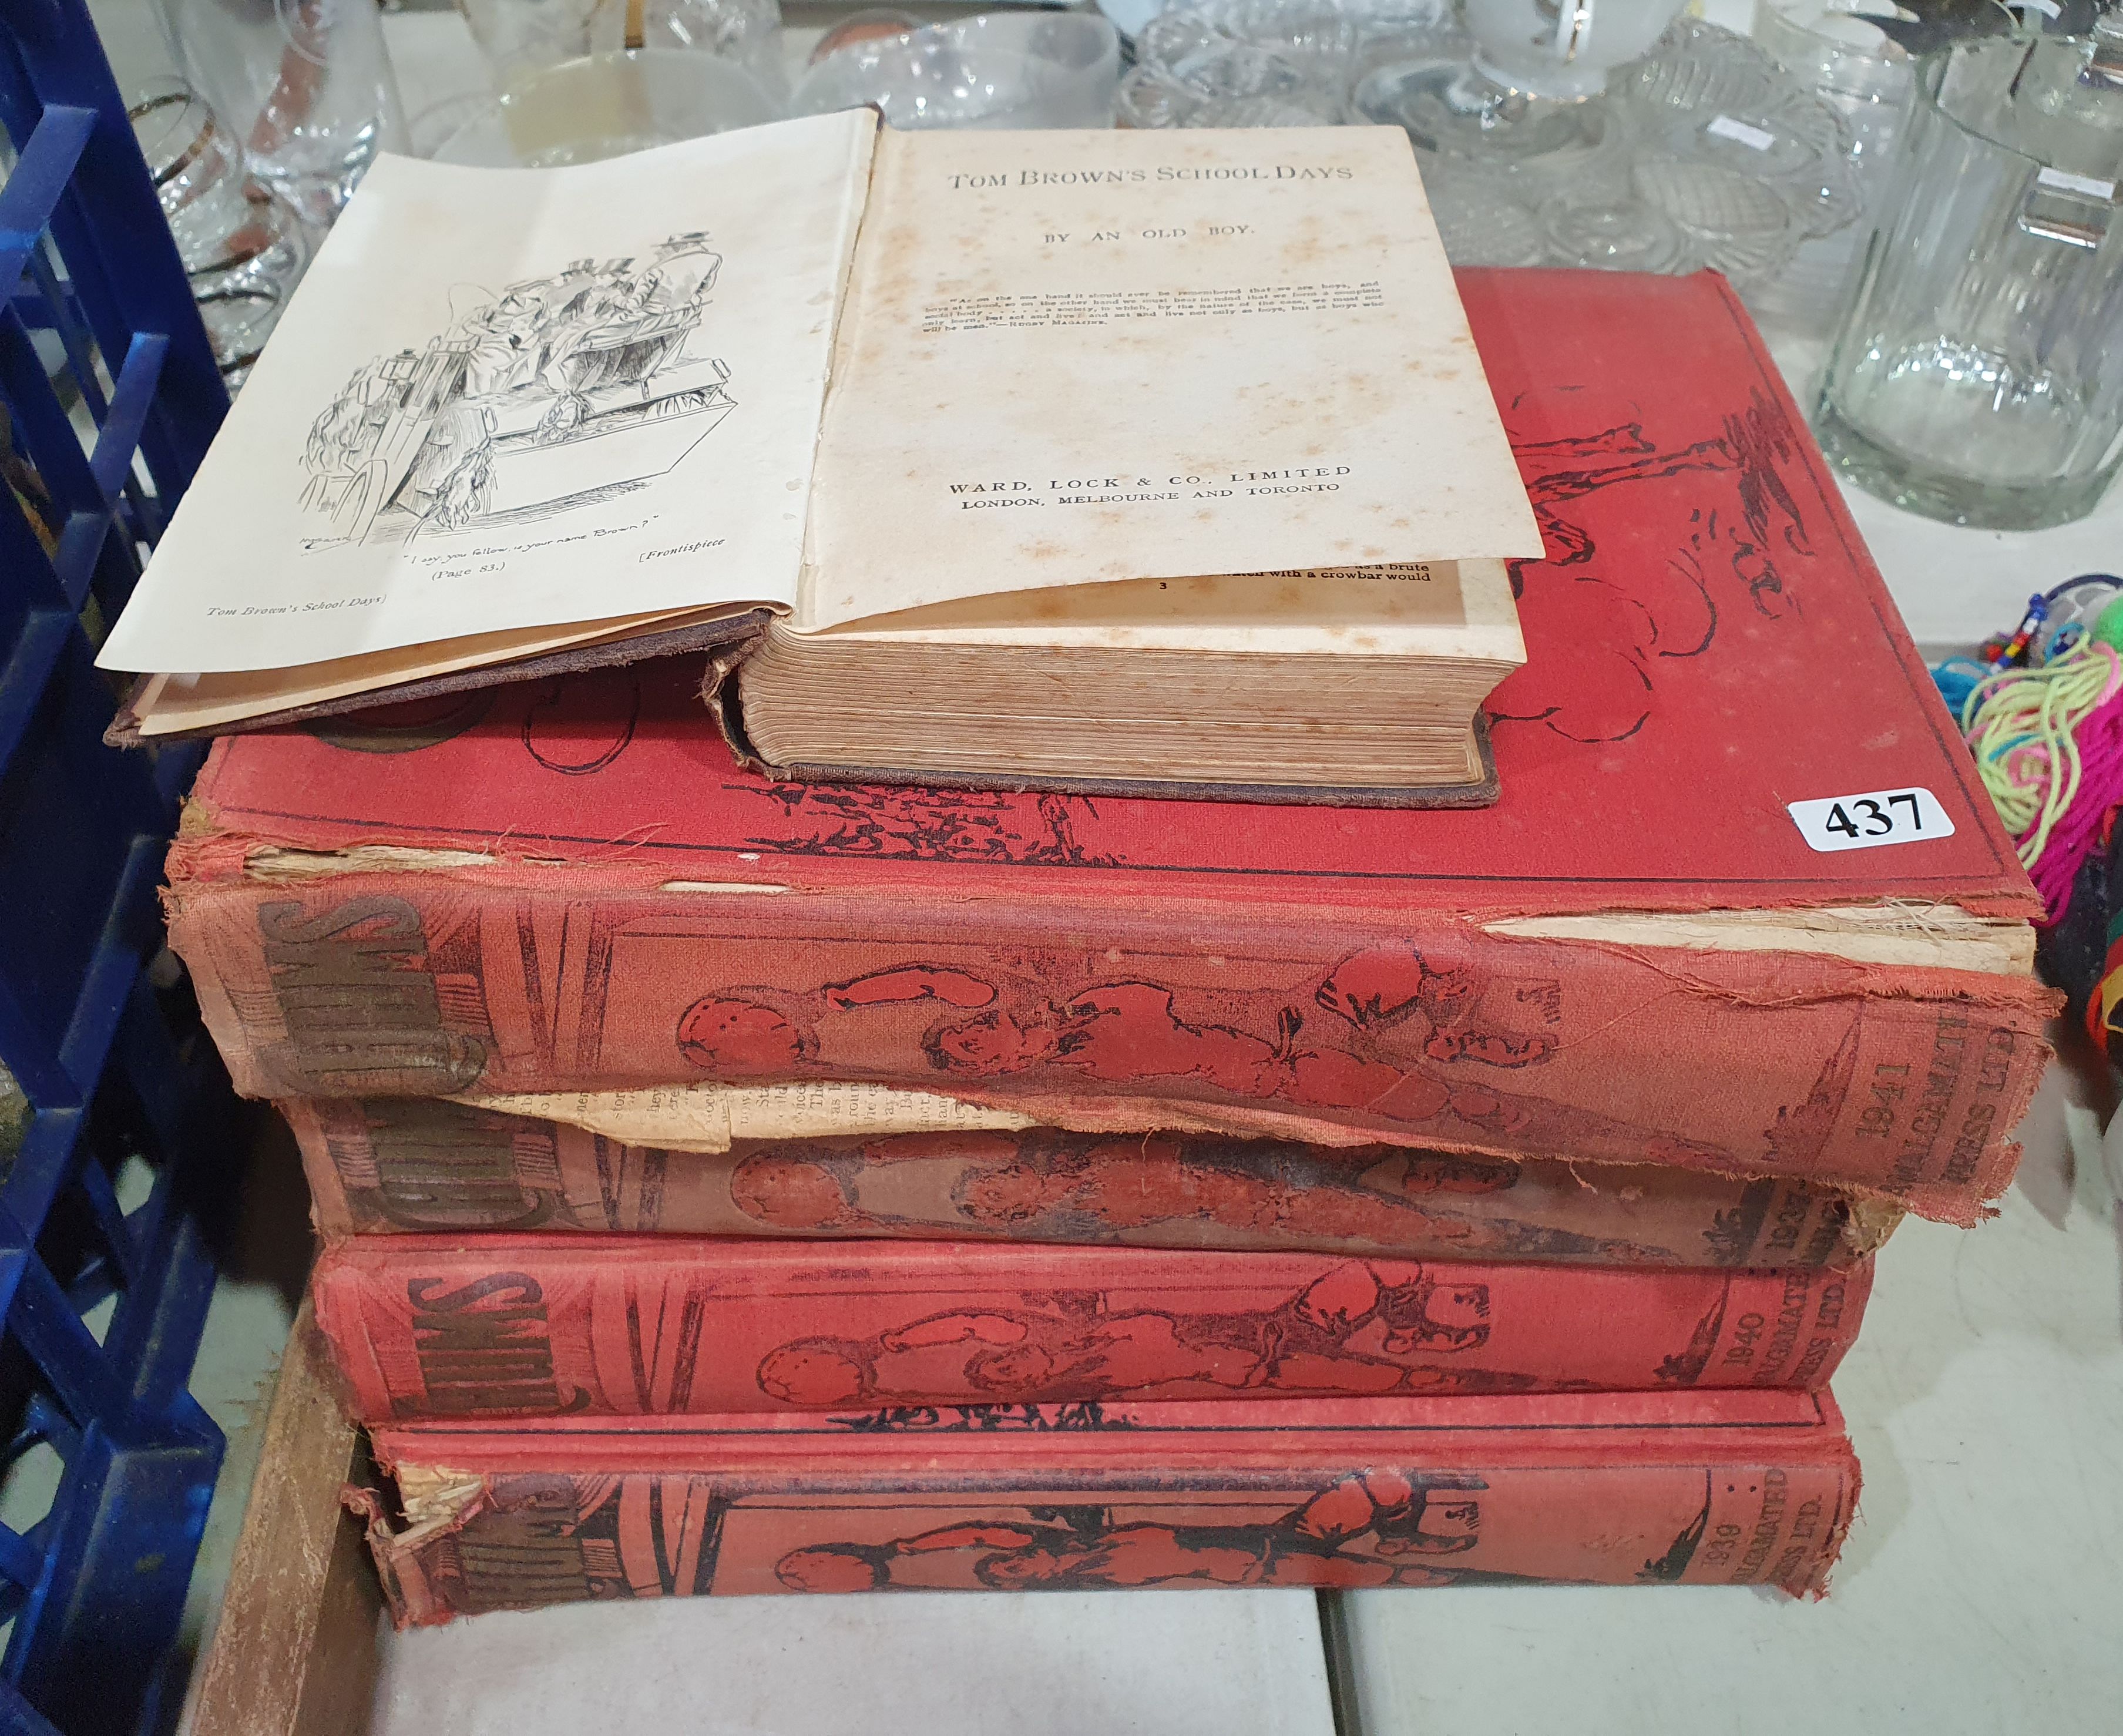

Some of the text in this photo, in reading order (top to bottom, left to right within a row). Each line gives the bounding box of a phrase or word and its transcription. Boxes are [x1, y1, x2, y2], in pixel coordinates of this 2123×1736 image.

[948, 166, 1353, 189] TOM BROWN'S SCHOOL DAYS
[1045, 224, 1255, 243] BY AN OLD BOY.
[949, 482, 1032, 494] WARD,
[1049, 478, 1120, 489] LOCK
[1137, 478, 1151, 486] &
[1230, 466, 1351, 482] LIMITED
[961, 483, 1339, 509] LONDON, MELBOURNE AND TORONTO
[441, 553, 467, 564] you
[522, 540, 553, 552] your
[557, 535, 587, 543] name
[432, 568, 472, 581] (Page
[1321, 570, 1382, 580] crowbar
[1386, 573, 1431, 582] would
[1389, 563, 1429, 572] brute
[207, 606, 237, 616] Tom
[241, 605, 297, 616] Brown's
[302, 599, 345, 612] School
[1825, 793, 1922, 838] 437
[1855, 1063, 1910, 1139] 1941
[1877, 1009, 1968, 1197] AMALGAMATE
[1722, 1312, 1764, 1368] 1940
